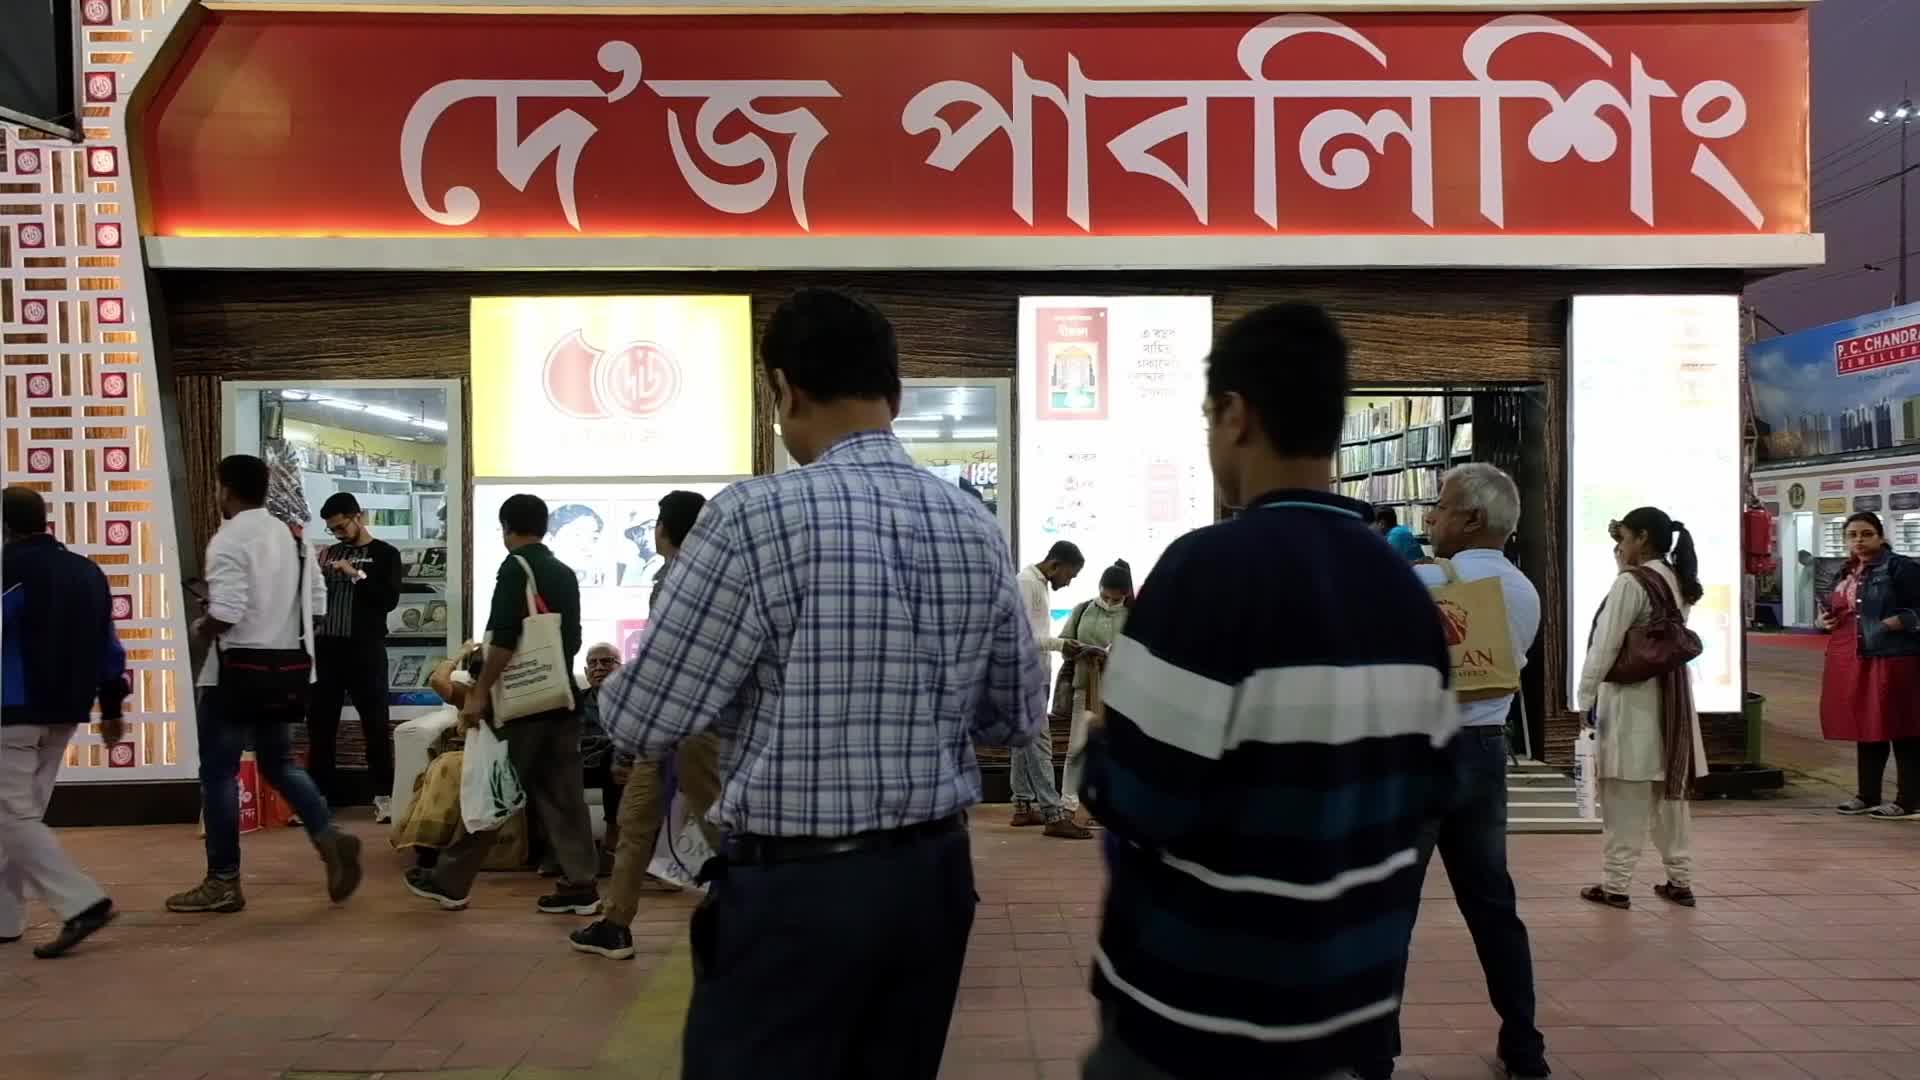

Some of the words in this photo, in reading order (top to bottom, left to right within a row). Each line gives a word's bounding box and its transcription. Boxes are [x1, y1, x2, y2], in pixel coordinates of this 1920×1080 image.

[400, 40, 842, 232] দে'জ
[901, 13, 1764, 232] পাবলিশিং
[1455, 648, 1493, 667] AN
